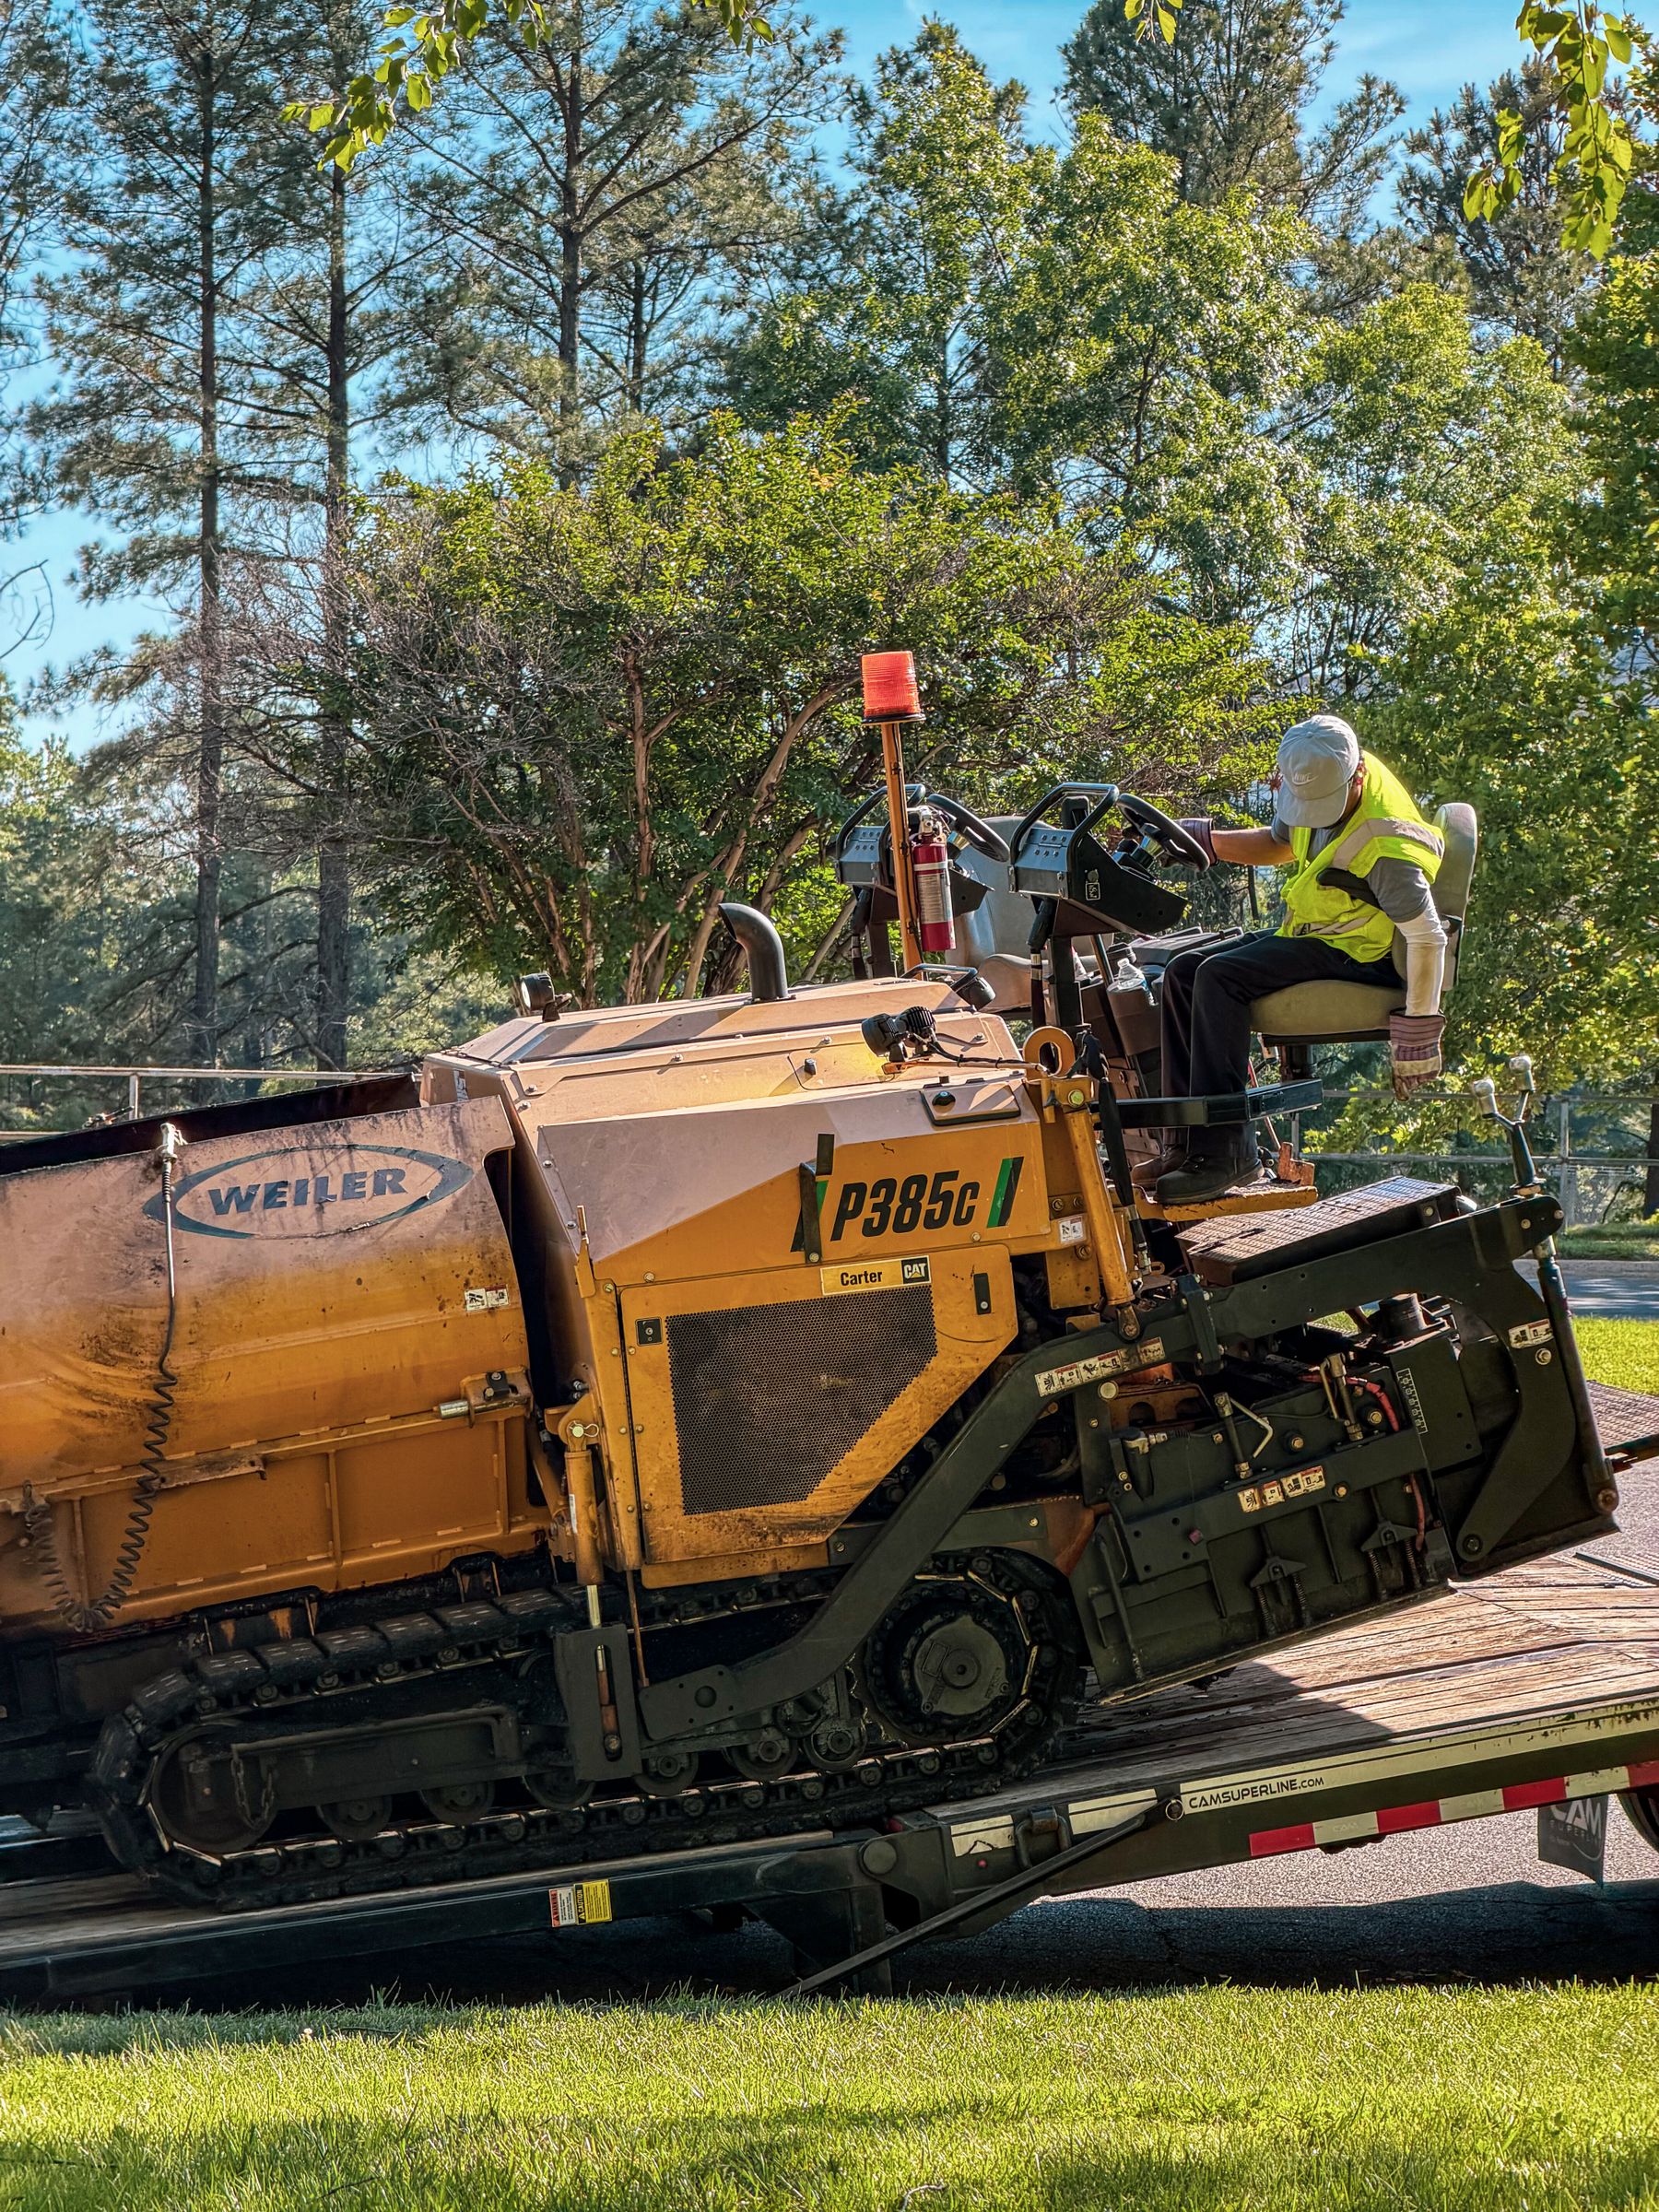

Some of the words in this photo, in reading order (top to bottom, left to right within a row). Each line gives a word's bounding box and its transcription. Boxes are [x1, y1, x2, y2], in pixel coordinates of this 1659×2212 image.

[208, 1168, 408, 1216] WEILER
[840, 1270, 883, 1287] Carter
[903, 1263, 926, 1279] CAT
[1189, 1776, 1324, 1809] CAMSUPERLINE.COM
[576, 1889, 585, 1913] CAUTION
